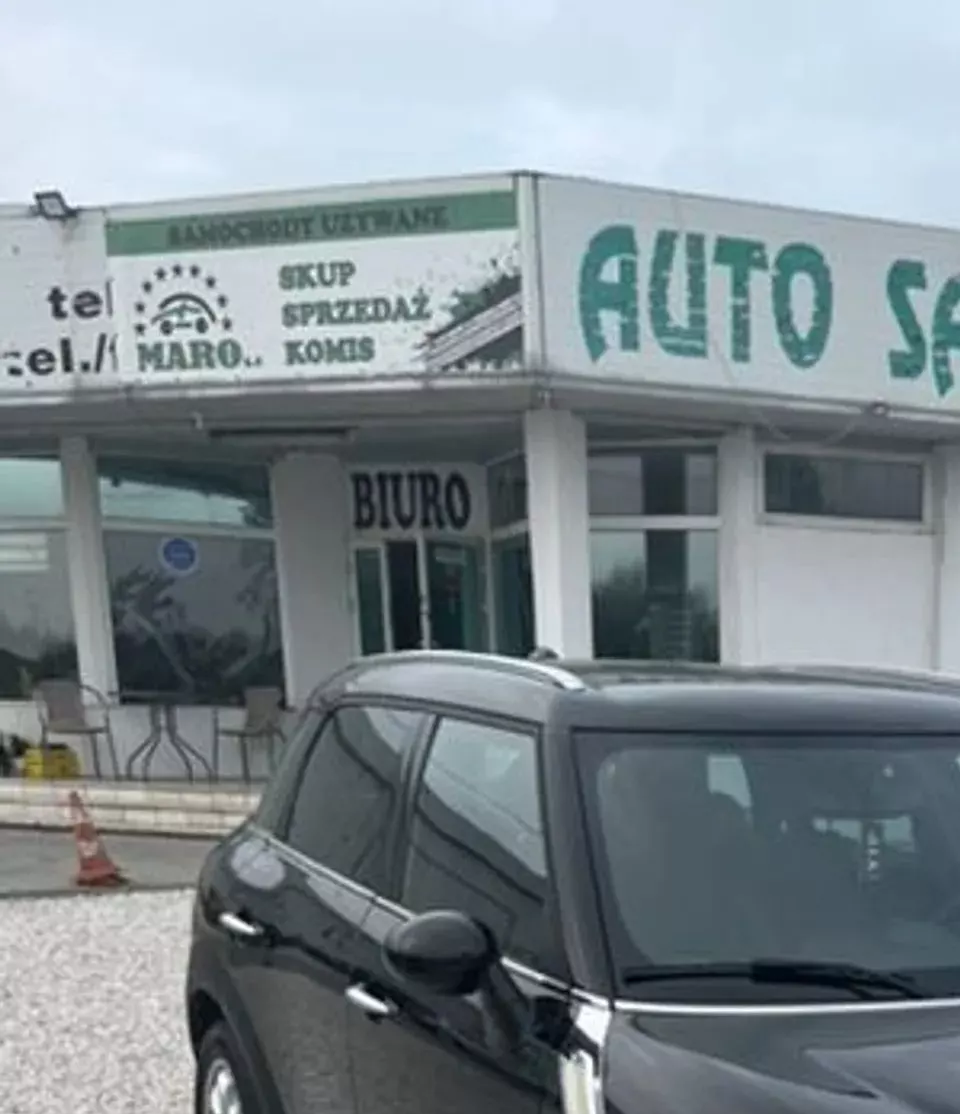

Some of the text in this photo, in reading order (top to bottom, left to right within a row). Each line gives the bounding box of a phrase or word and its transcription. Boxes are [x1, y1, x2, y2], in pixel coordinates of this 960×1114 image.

[278, 261, 356, 291] SKUP
[282, 287, 432, 328] SPRZEDAŻ
[577, 224, 833, 370] AUTO
[284, 336, 375, 367] KOMIS
[352, 470, 472, 532] BIURO
